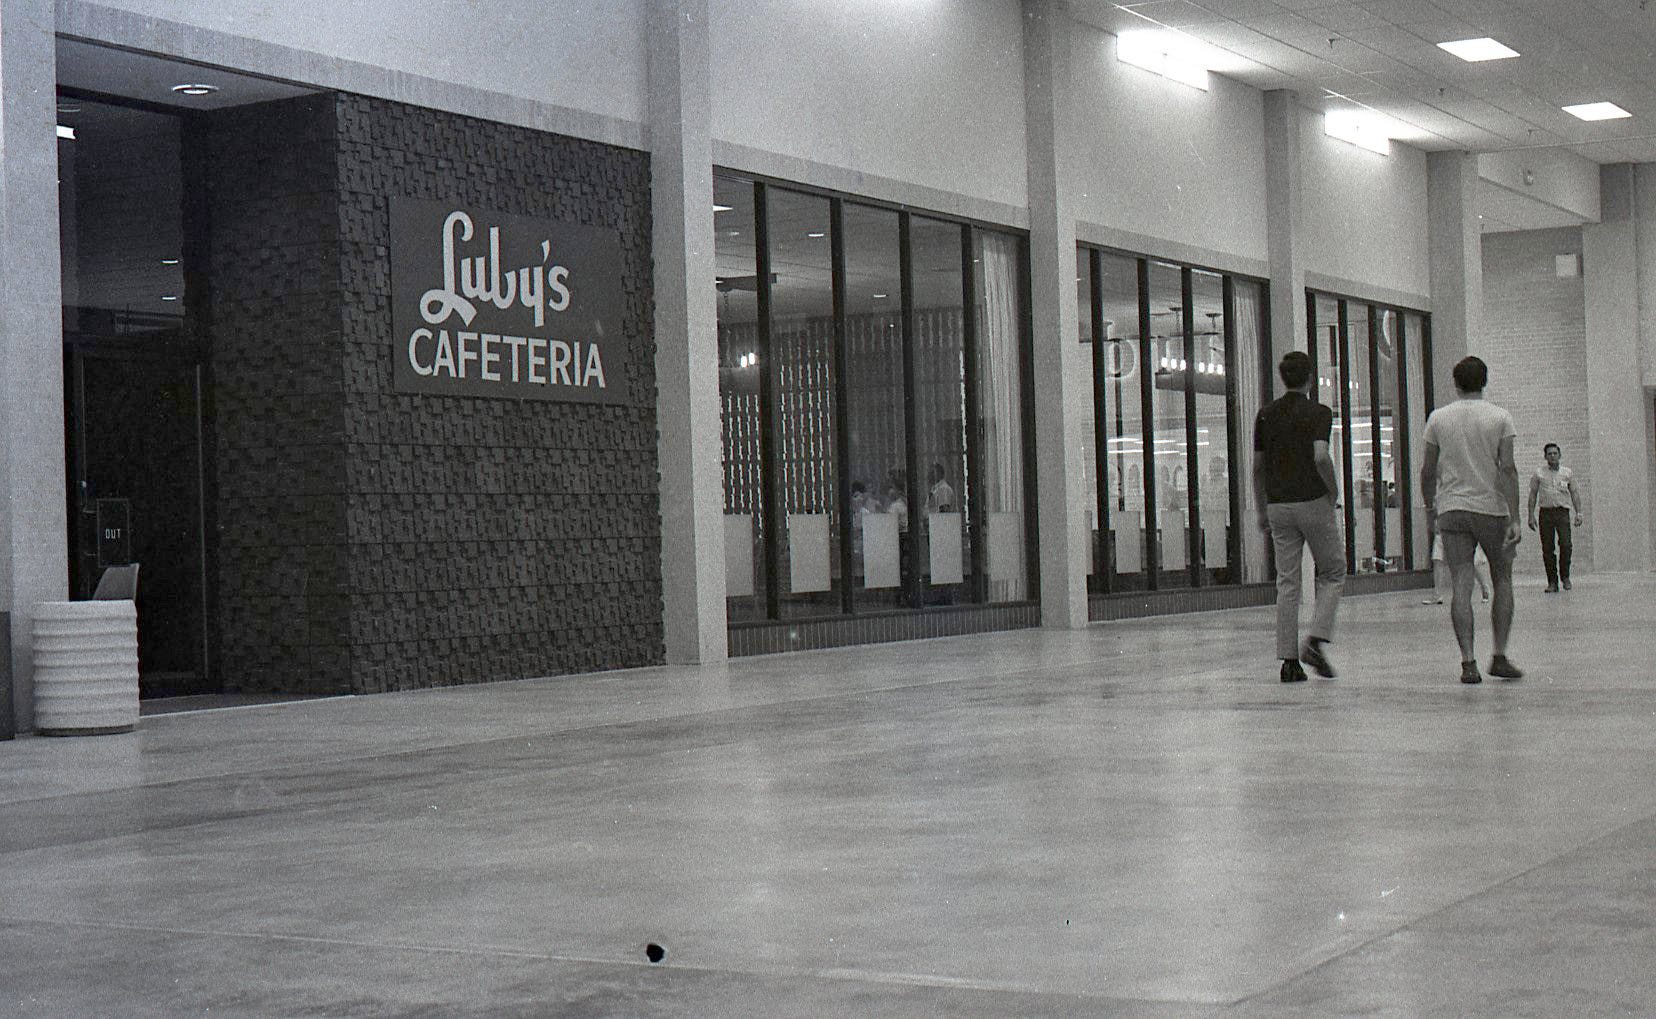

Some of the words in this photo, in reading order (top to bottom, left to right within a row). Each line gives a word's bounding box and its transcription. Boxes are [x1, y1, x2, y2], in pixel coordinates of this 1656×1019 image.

[419, 210, 571, 328] Luby's
[408, 327, 606, 389] CAFETERIA
[105, 528, 120, 539] OUT
